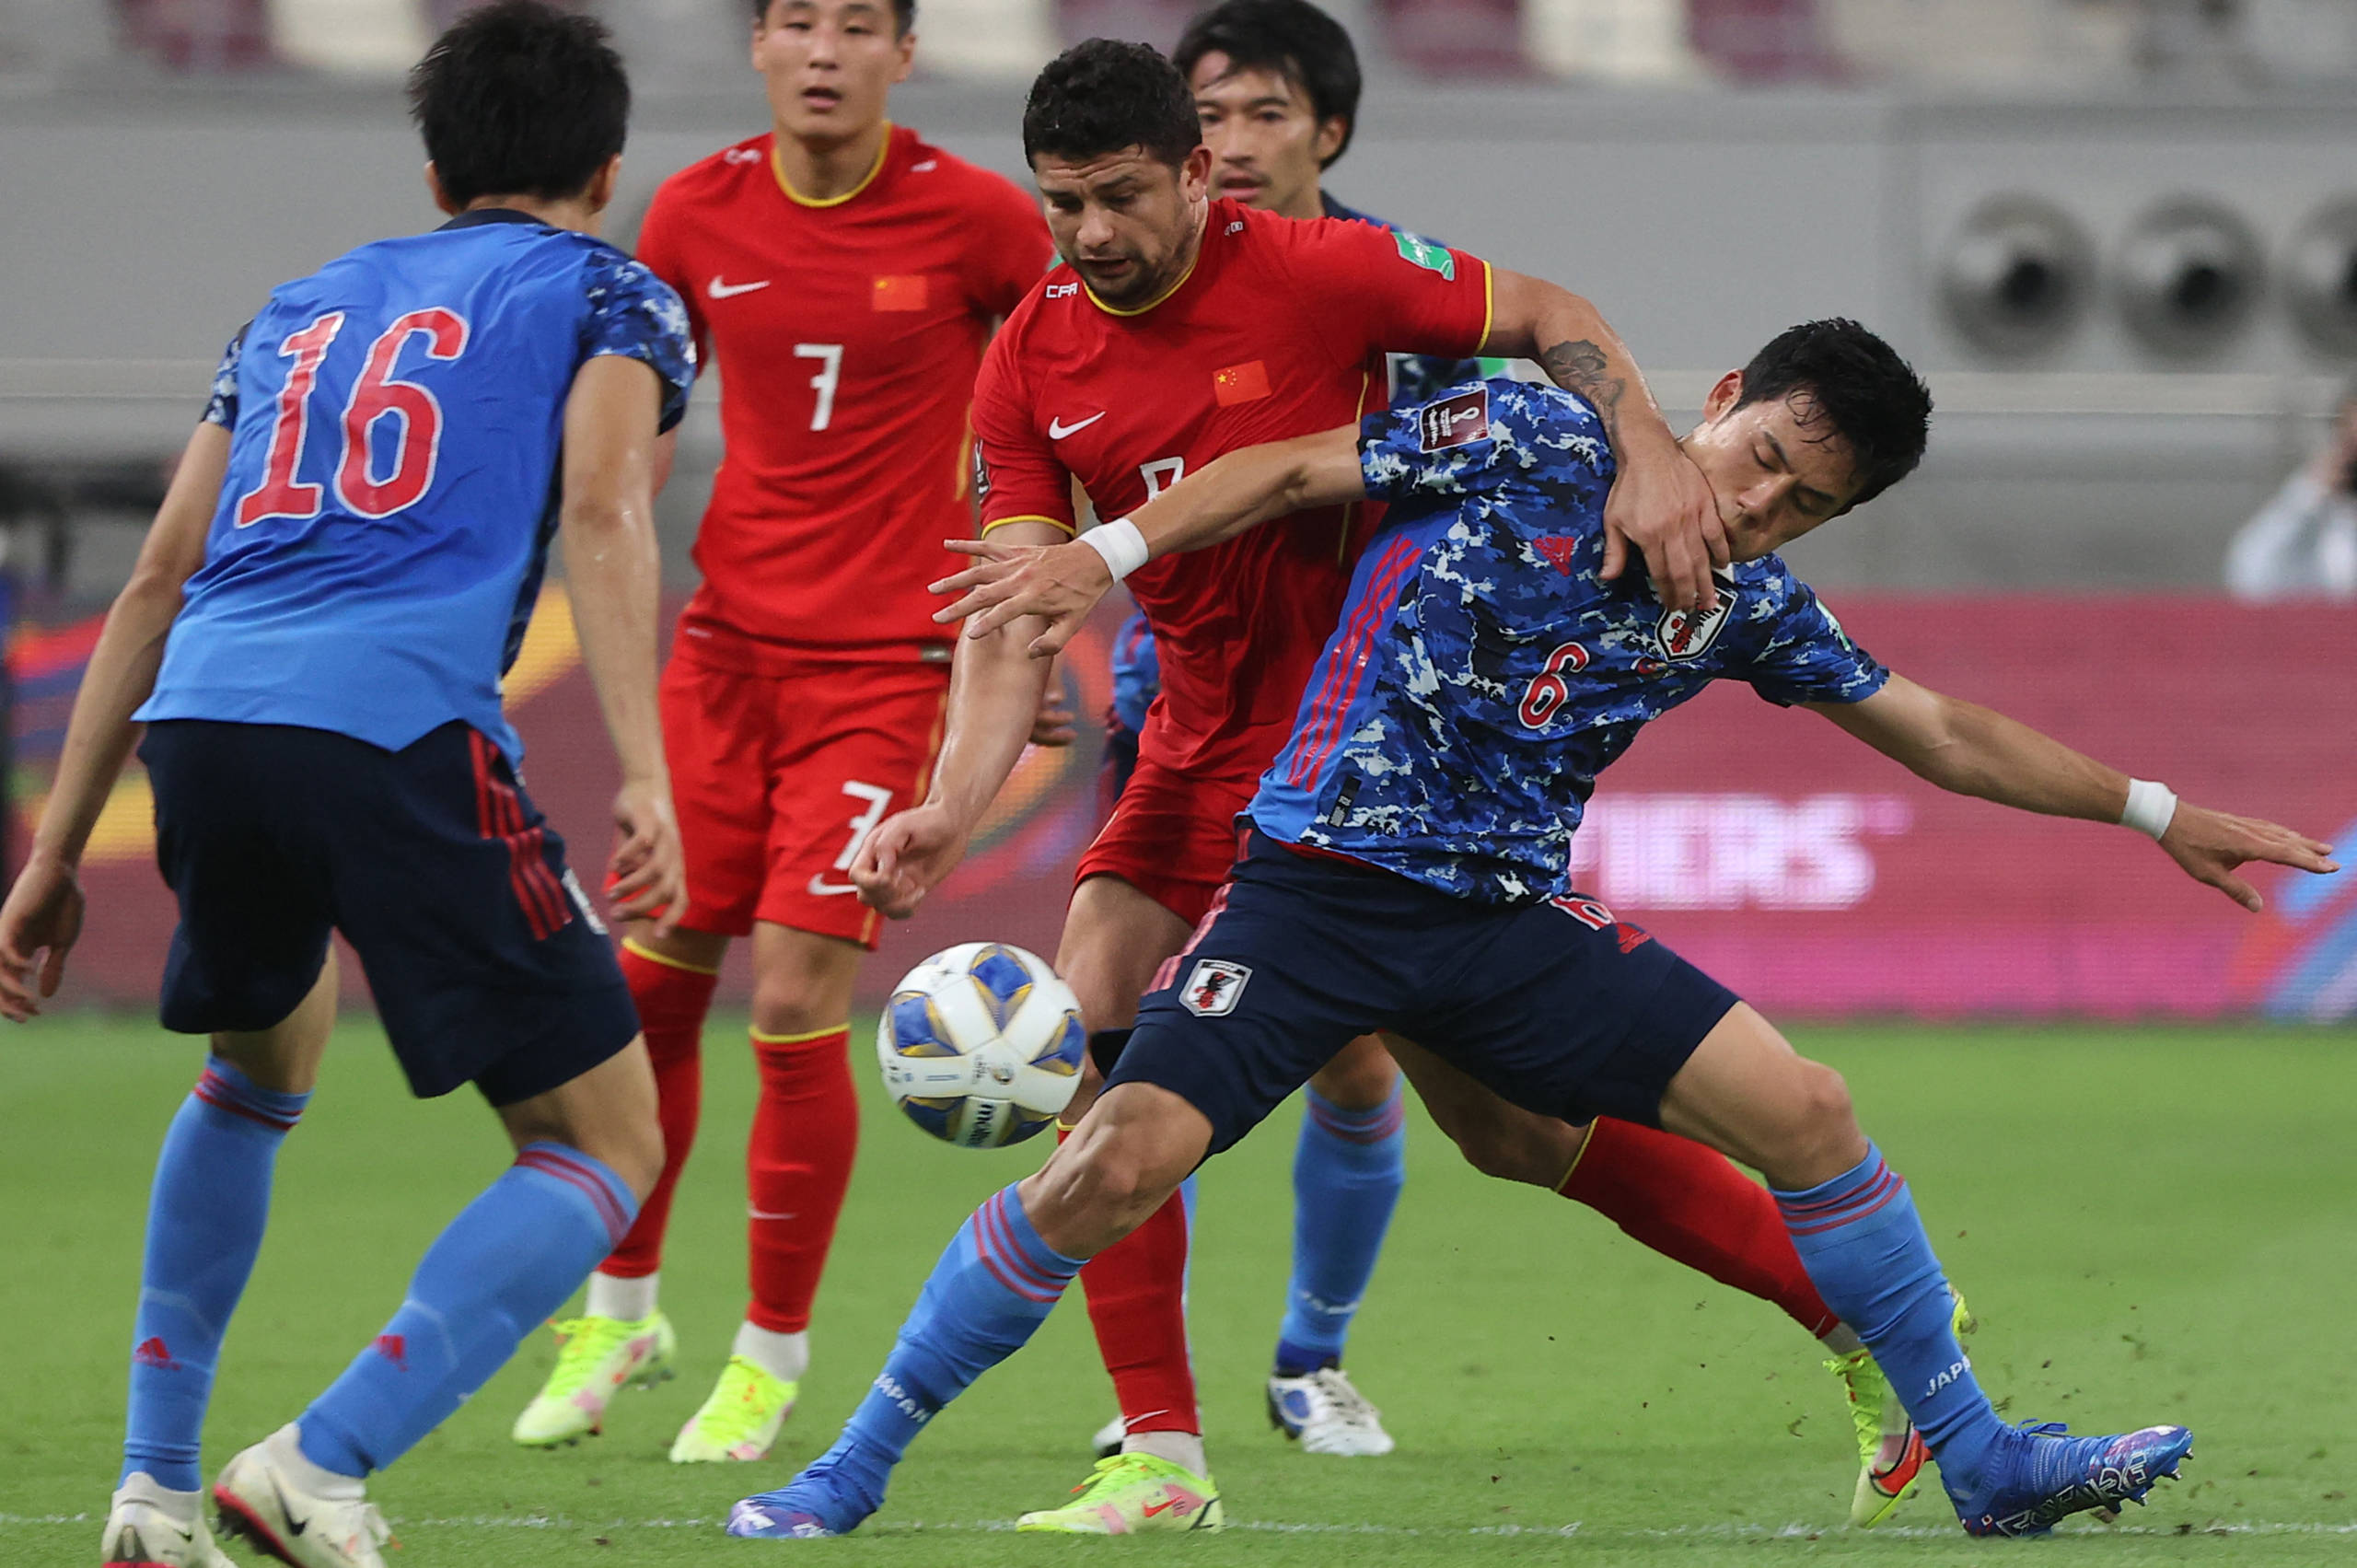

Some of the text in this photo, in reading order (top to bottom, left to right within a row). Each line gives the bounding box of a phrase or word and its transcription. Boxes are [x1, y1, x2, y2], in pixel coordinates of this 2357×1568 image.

[1046, 282, 1078, 298] CFA
[234, 306, 470, 528] 16
[793, 343, 844, 432] 7
[1518, 642, 1589, 729] 6
[832, 779, 894, 871] 7
